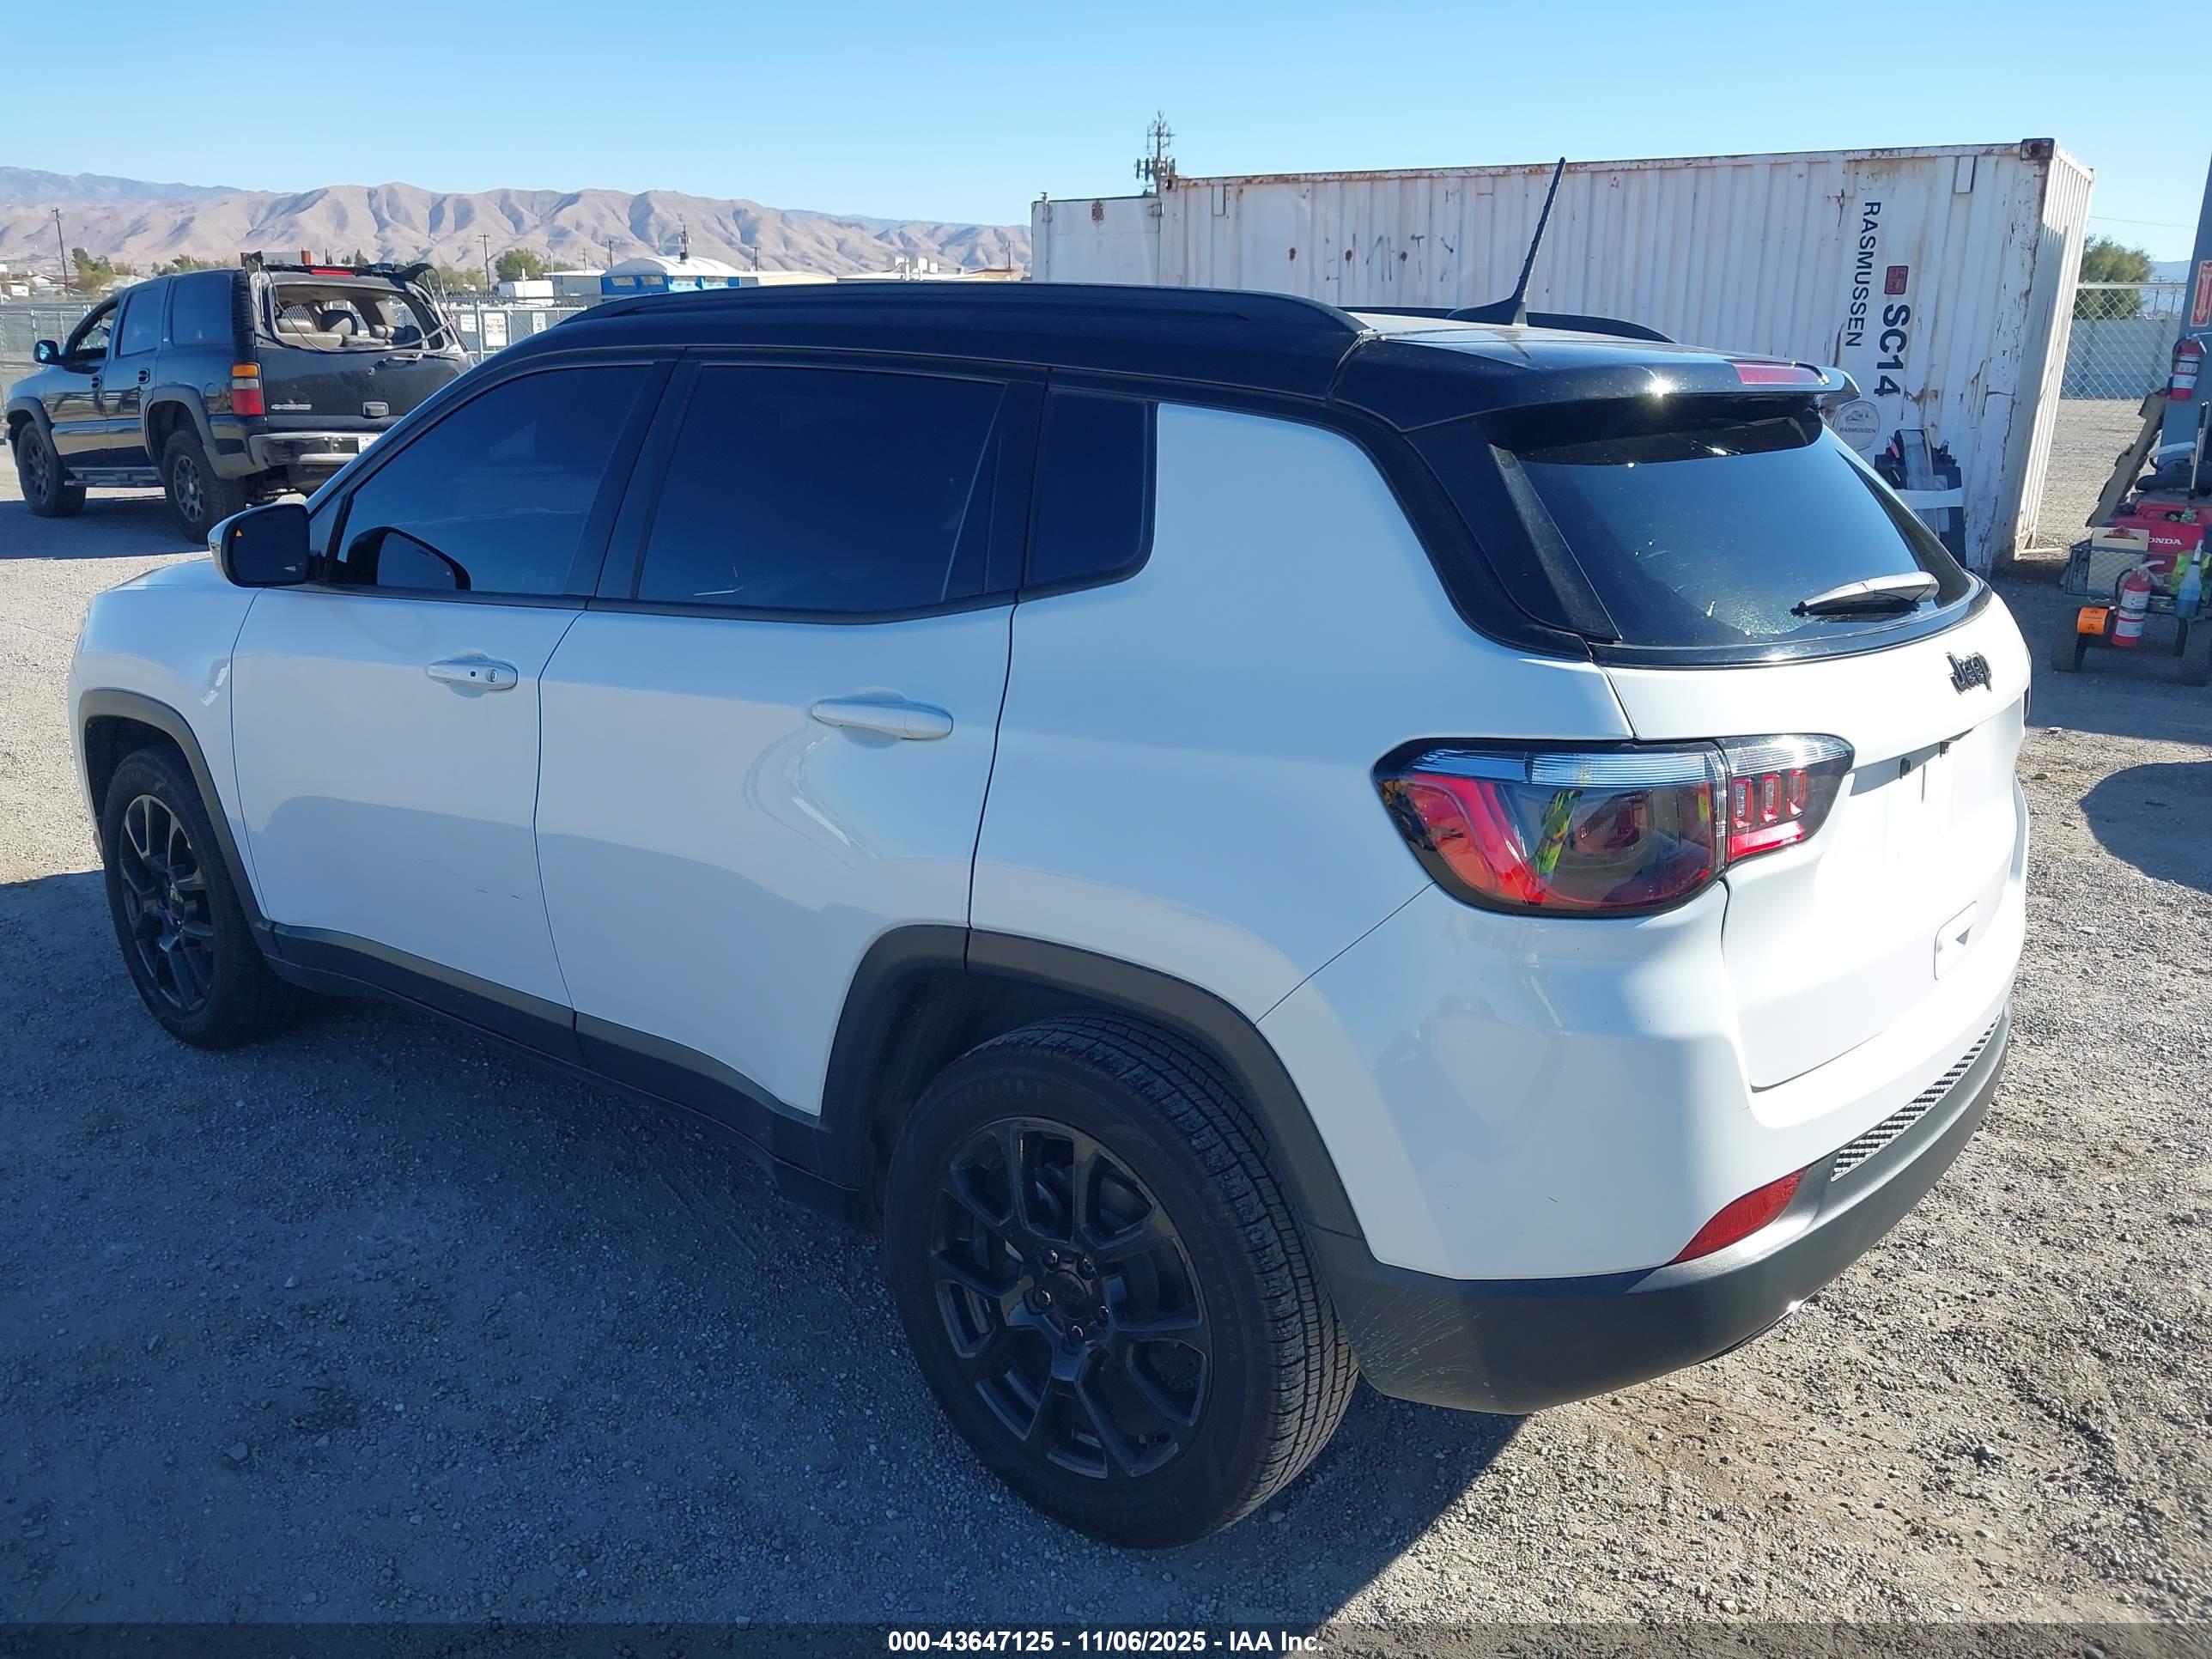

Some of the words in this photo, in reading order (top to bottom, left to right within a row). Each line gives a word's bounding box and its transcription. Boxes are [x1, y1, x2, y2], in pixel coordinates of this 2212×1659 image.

[1844, 201, 1881, 347] RASMUSSEN
[1874, 303, 1911, 397] SC14
[2148, 537, 2183, 545] ONDA
[1945, 651, 1992, 695] Jeep
